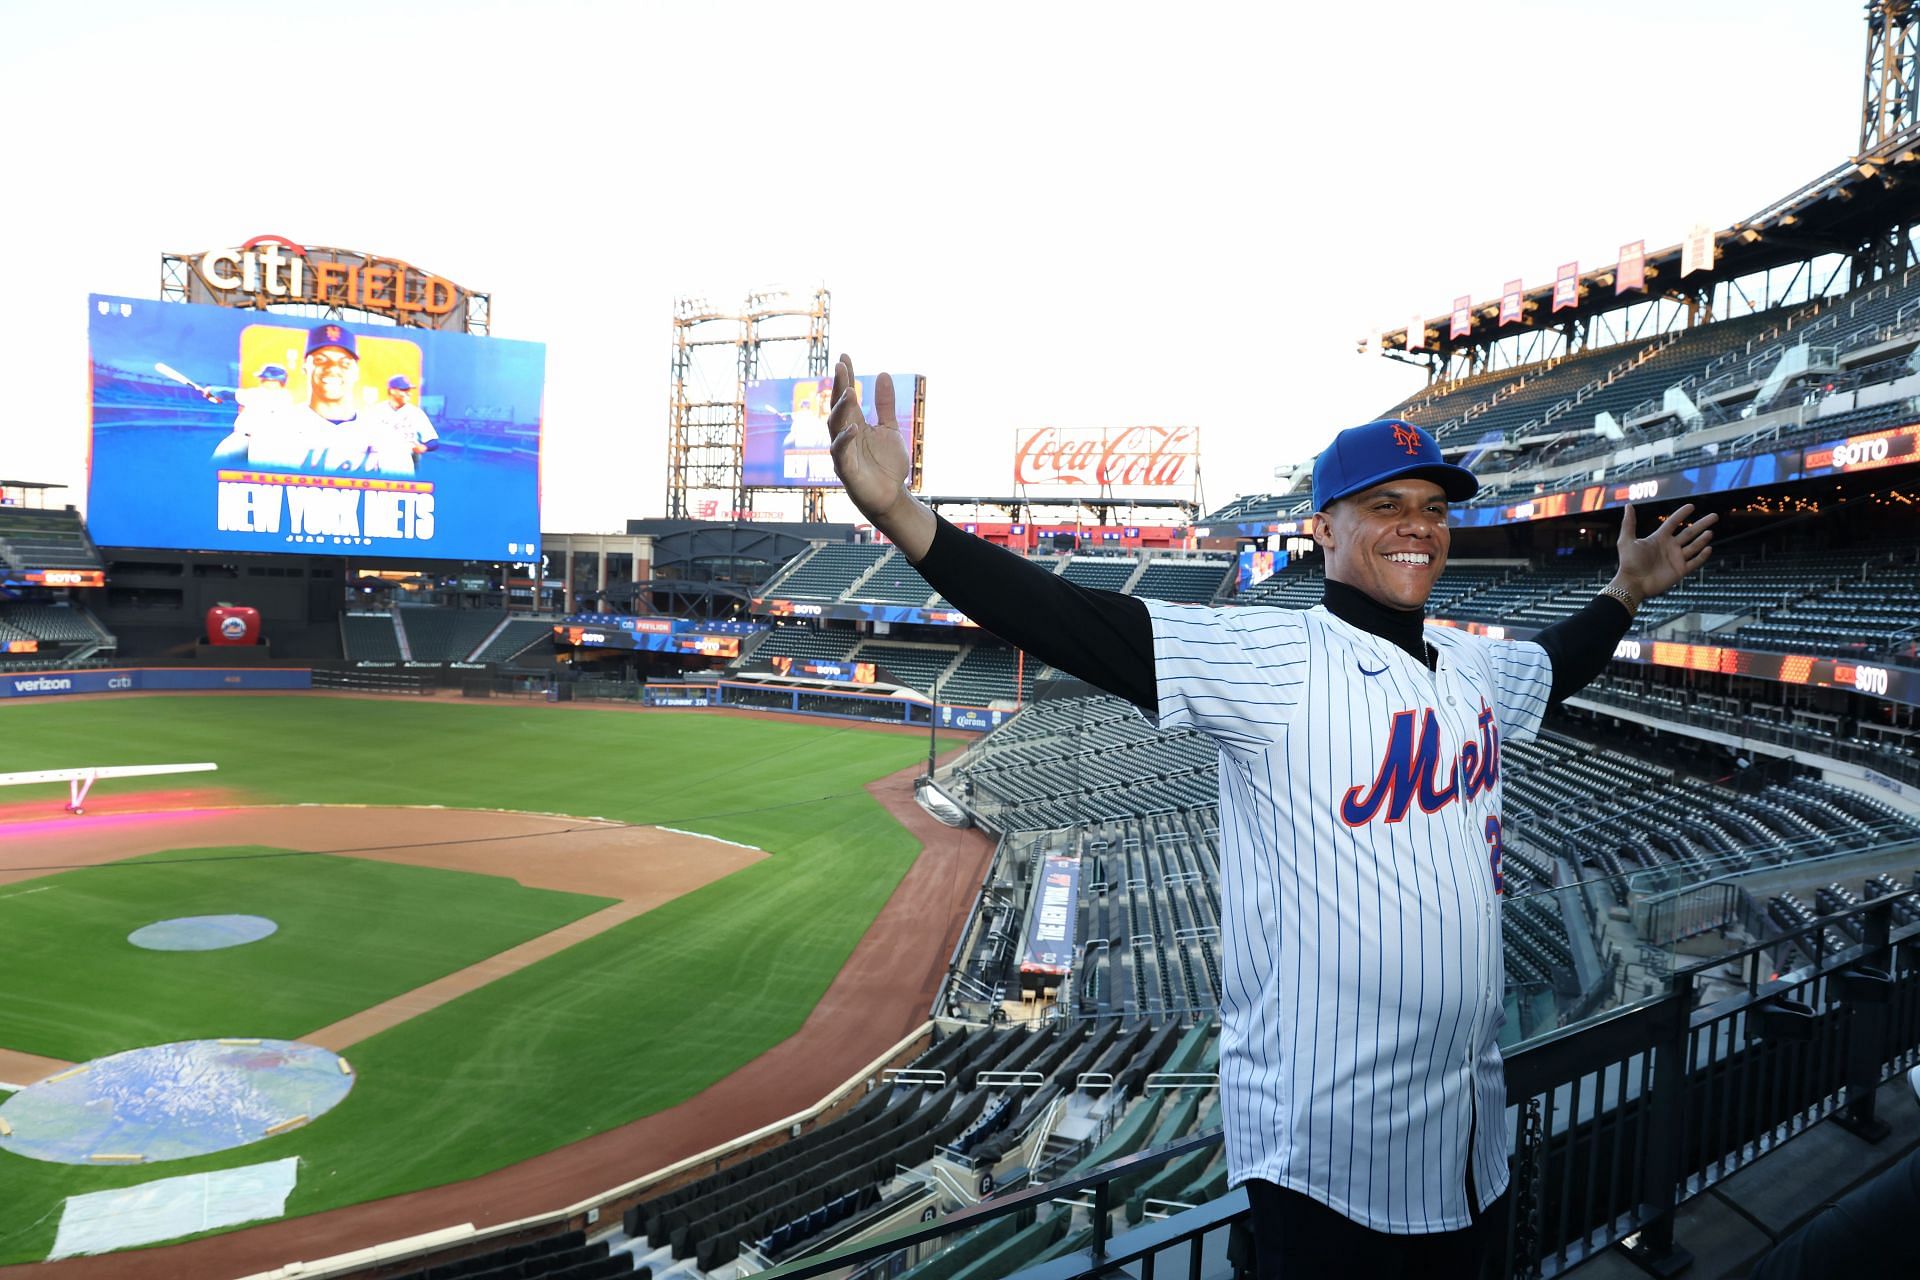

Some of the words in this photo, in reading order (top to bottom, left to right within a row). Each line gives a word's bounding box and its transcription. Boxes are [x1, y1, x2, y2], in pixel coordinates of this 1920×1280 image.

[317, 261, 456, 314] FIELD
[1832, 438, 1888, 467] SOTO
[242, 474, 335, 486] WELCOME
[351, 480, 371, 488] TO
[385, 483, 417, 491] THE
[1628, 480, 1658, 500] SOTO
[218, 482, 283, 533] NEW
[286, 486, 361, 536] YORK
[363, 490, 435, 540] METS
[794, 605, 821, 614] SOTO
[582, 634, 605, 642] SOTO
[817, 666, 841, 674] SOTO
[15, 678, 71, 691] verizon
[108, 677, 131, 688] citi
[1855, 665, 1888, 695] SOTO
[956, 715, 986, 727] Corona
